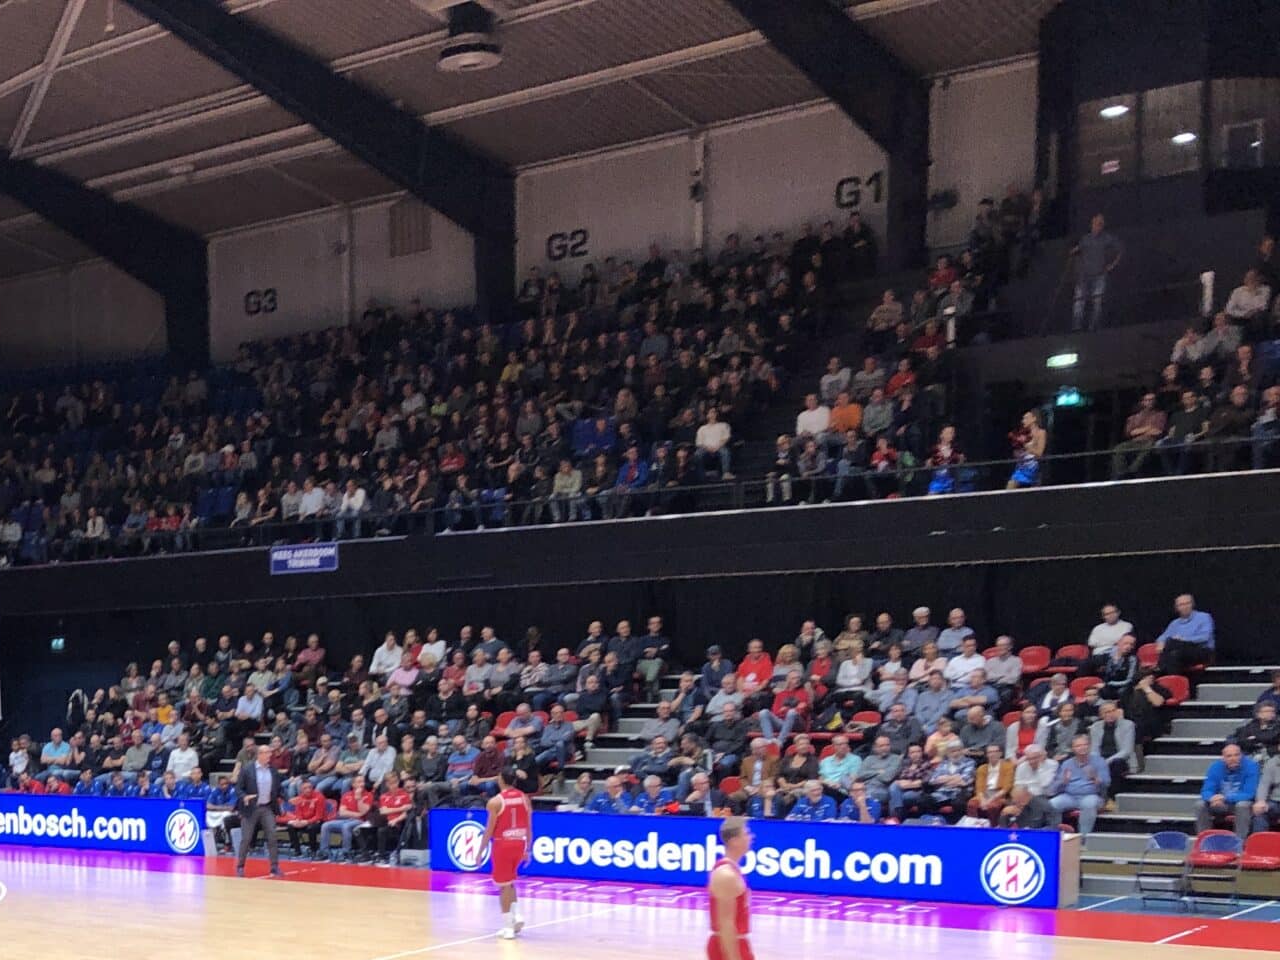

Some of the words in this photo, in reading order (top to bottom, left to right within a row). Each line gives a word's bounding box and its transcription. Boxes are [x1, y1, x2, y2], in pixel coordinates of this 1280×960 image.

[835, 171, 885, 210] G1
[547, 228, 588, 261] G2
[244, 288, 278, 316] G3
[532, 828, 943, 888] eroesdenbosch.com
